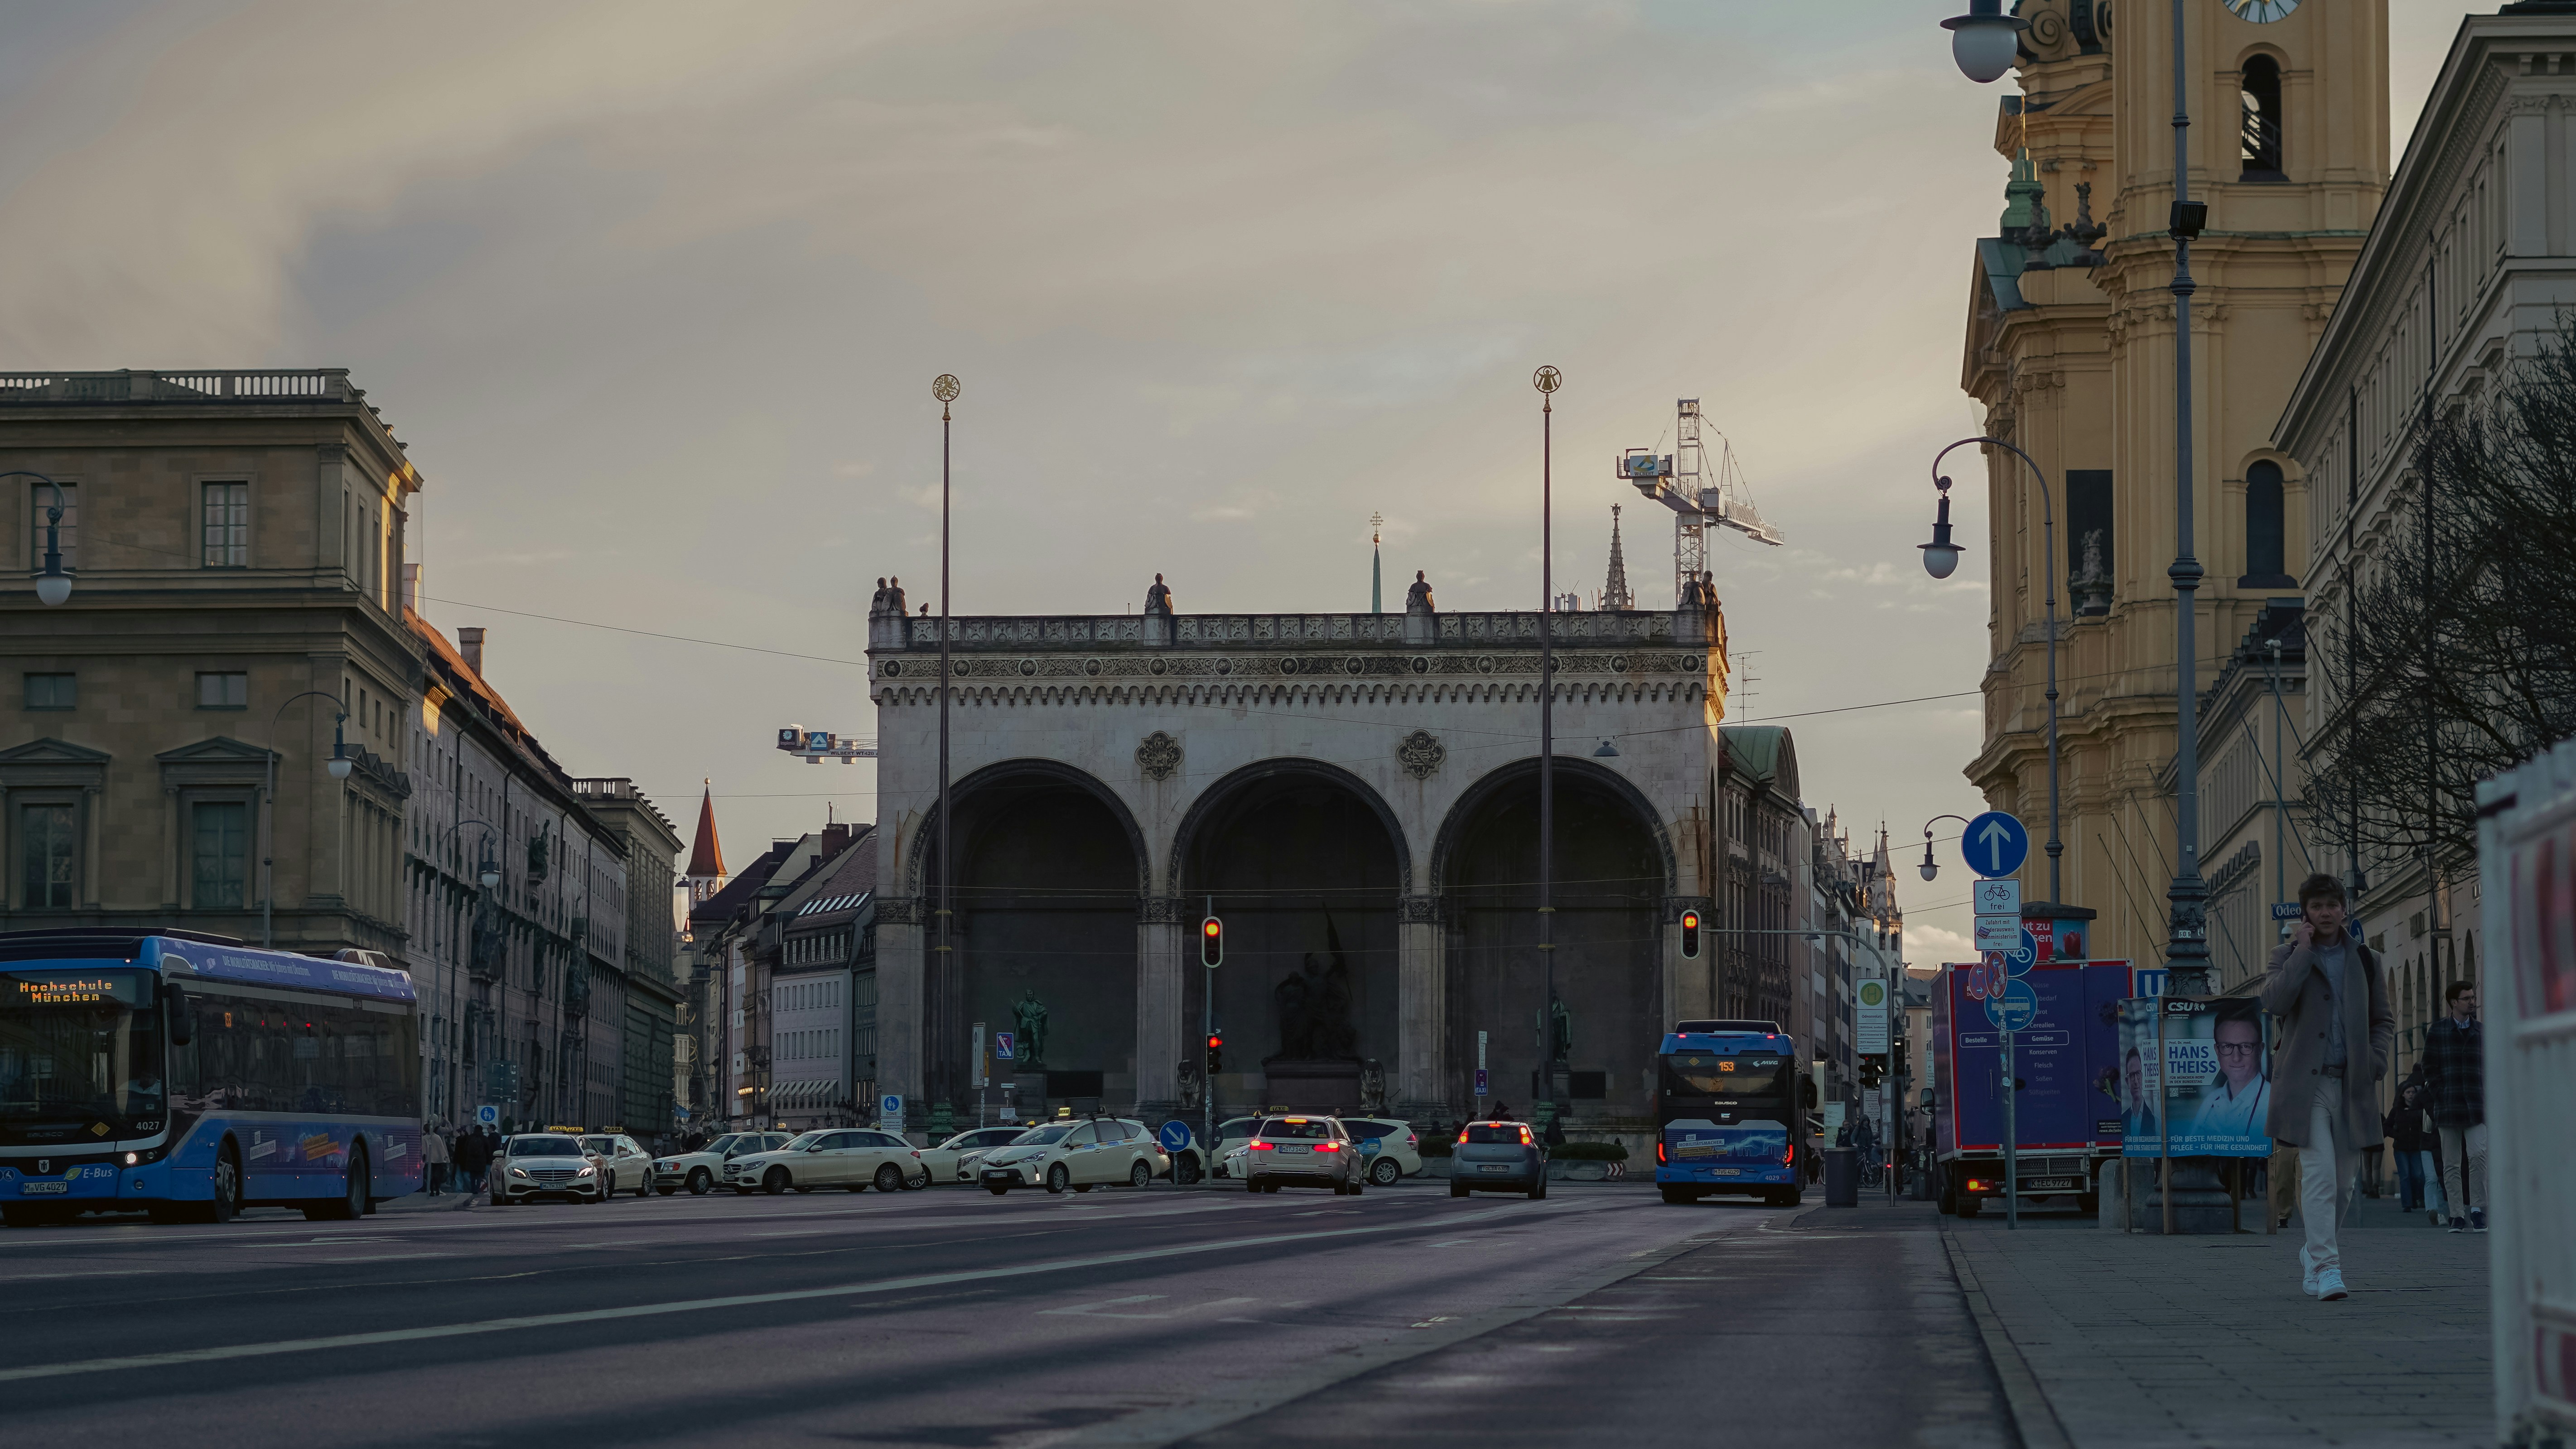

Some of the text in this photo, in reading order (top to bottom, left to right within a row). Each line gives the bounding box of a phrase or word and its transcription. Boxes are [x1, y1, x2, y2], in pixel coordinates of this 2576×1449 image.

[2276, 905, 2301, 916] Odeo
[2021, 922, 2033, 930] ut
[222, 955, 231, 966] DIE
[230, 956, 270, 971] MOBILITÄTSMACHER:
[20, 980, 113, 992] Hochschule
[2144, 974, 2165, 997] U
[32, 992, 99, 1002] München
[1867, 988, 1877, 1001] H
[2146, 1002, 2155, 1012] CSU
[2168, 1002, 2194, 1011] CSU
[2143, 1046, 2156, 1061] HANS
[2169, 1046, 2209, 1059] HANS
[1718, 1061, 1734, 1072] 153
[2144, 1063, 2159, 1077] THEISS
[2168, 1060, 2217, 1074] THEISS
[136, 1122, 160, 1131] 4027
[83, 1168, 112, 1179] E-Bus
[24, 1182, 66, 1192] M VG 4027
